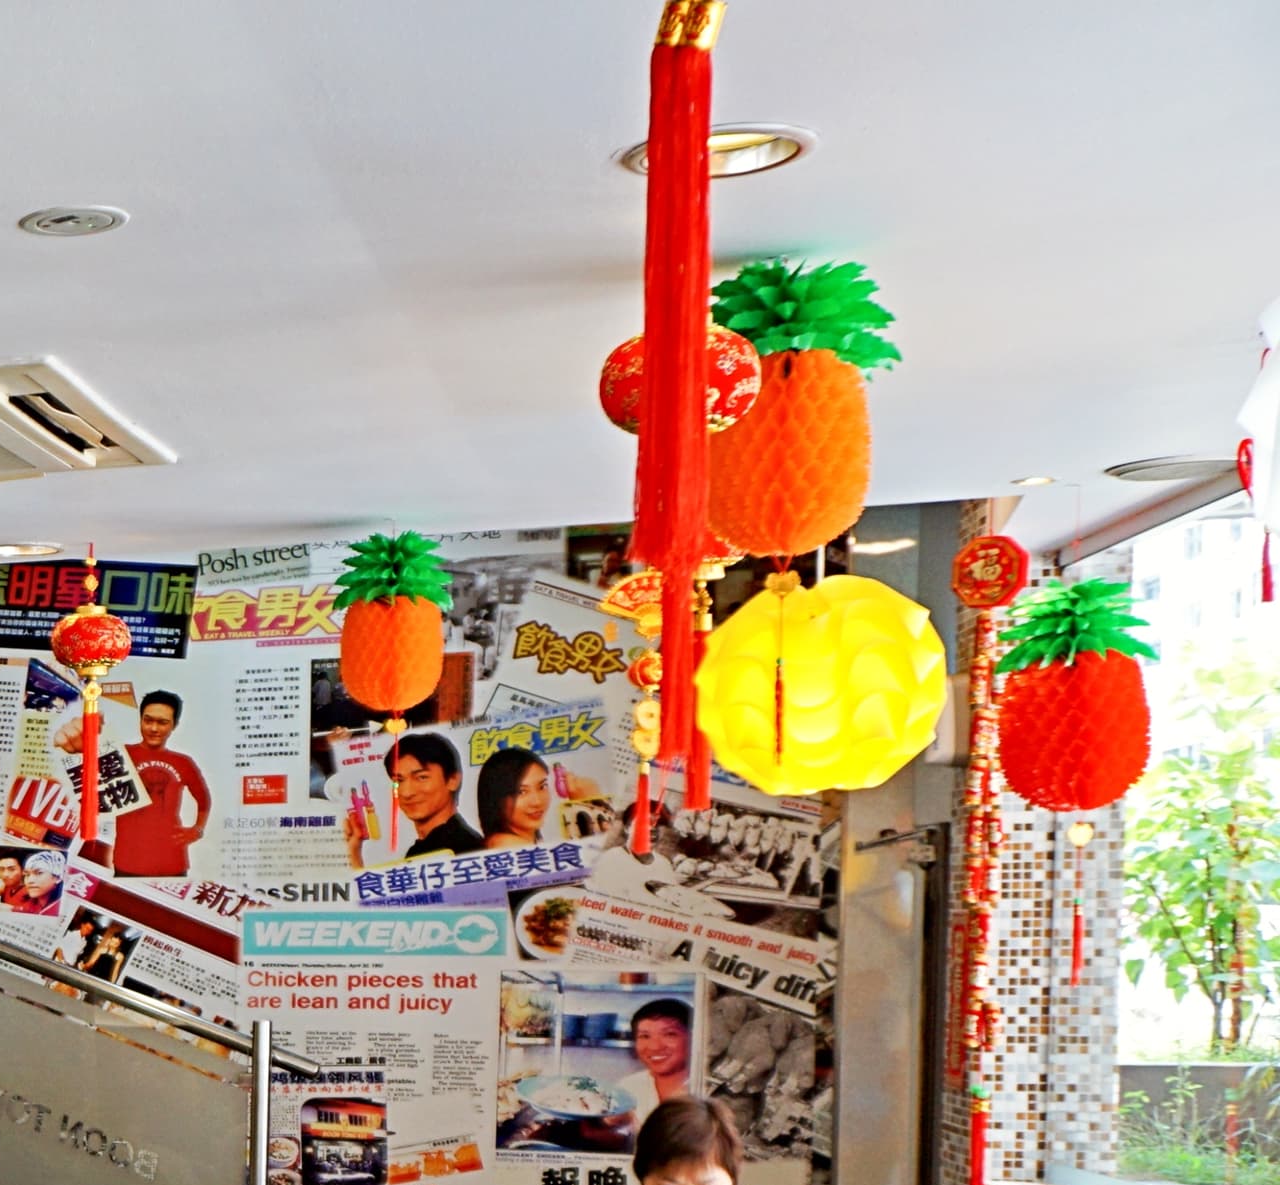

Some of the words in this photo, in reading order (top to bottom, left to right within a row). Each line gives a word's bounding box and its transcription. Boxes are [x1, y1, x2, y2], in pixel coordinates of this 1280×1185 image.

[198, 548, 248, 576] Posh
[253, 543, 310, 566] street
[355, 842, 585, 900] 食華仔至愛美食
[254, 921, 450, 949] WEEKEND
[581, 896, 606, 912] Iced
[610, 904, 644, 920] water
[648, 914, 689, 933] makes
[693, 924, 703, 936] it
[706, 928, 753, 947] smooth
[757, 940, 782, 954] and
[786, 947, 818, 965] juicy
[672, 940, 694, 962] A
[247, 971, 338, 988] Chicken
[347, 973, 424, 990] pieces
[433, 972, 477, 989] that
[247, 996, 282, 1009] are
[291, 993, 338, 1009] lean
[351, 993, 391, 1009] and
[399, 993, 453, 1014] juicy
